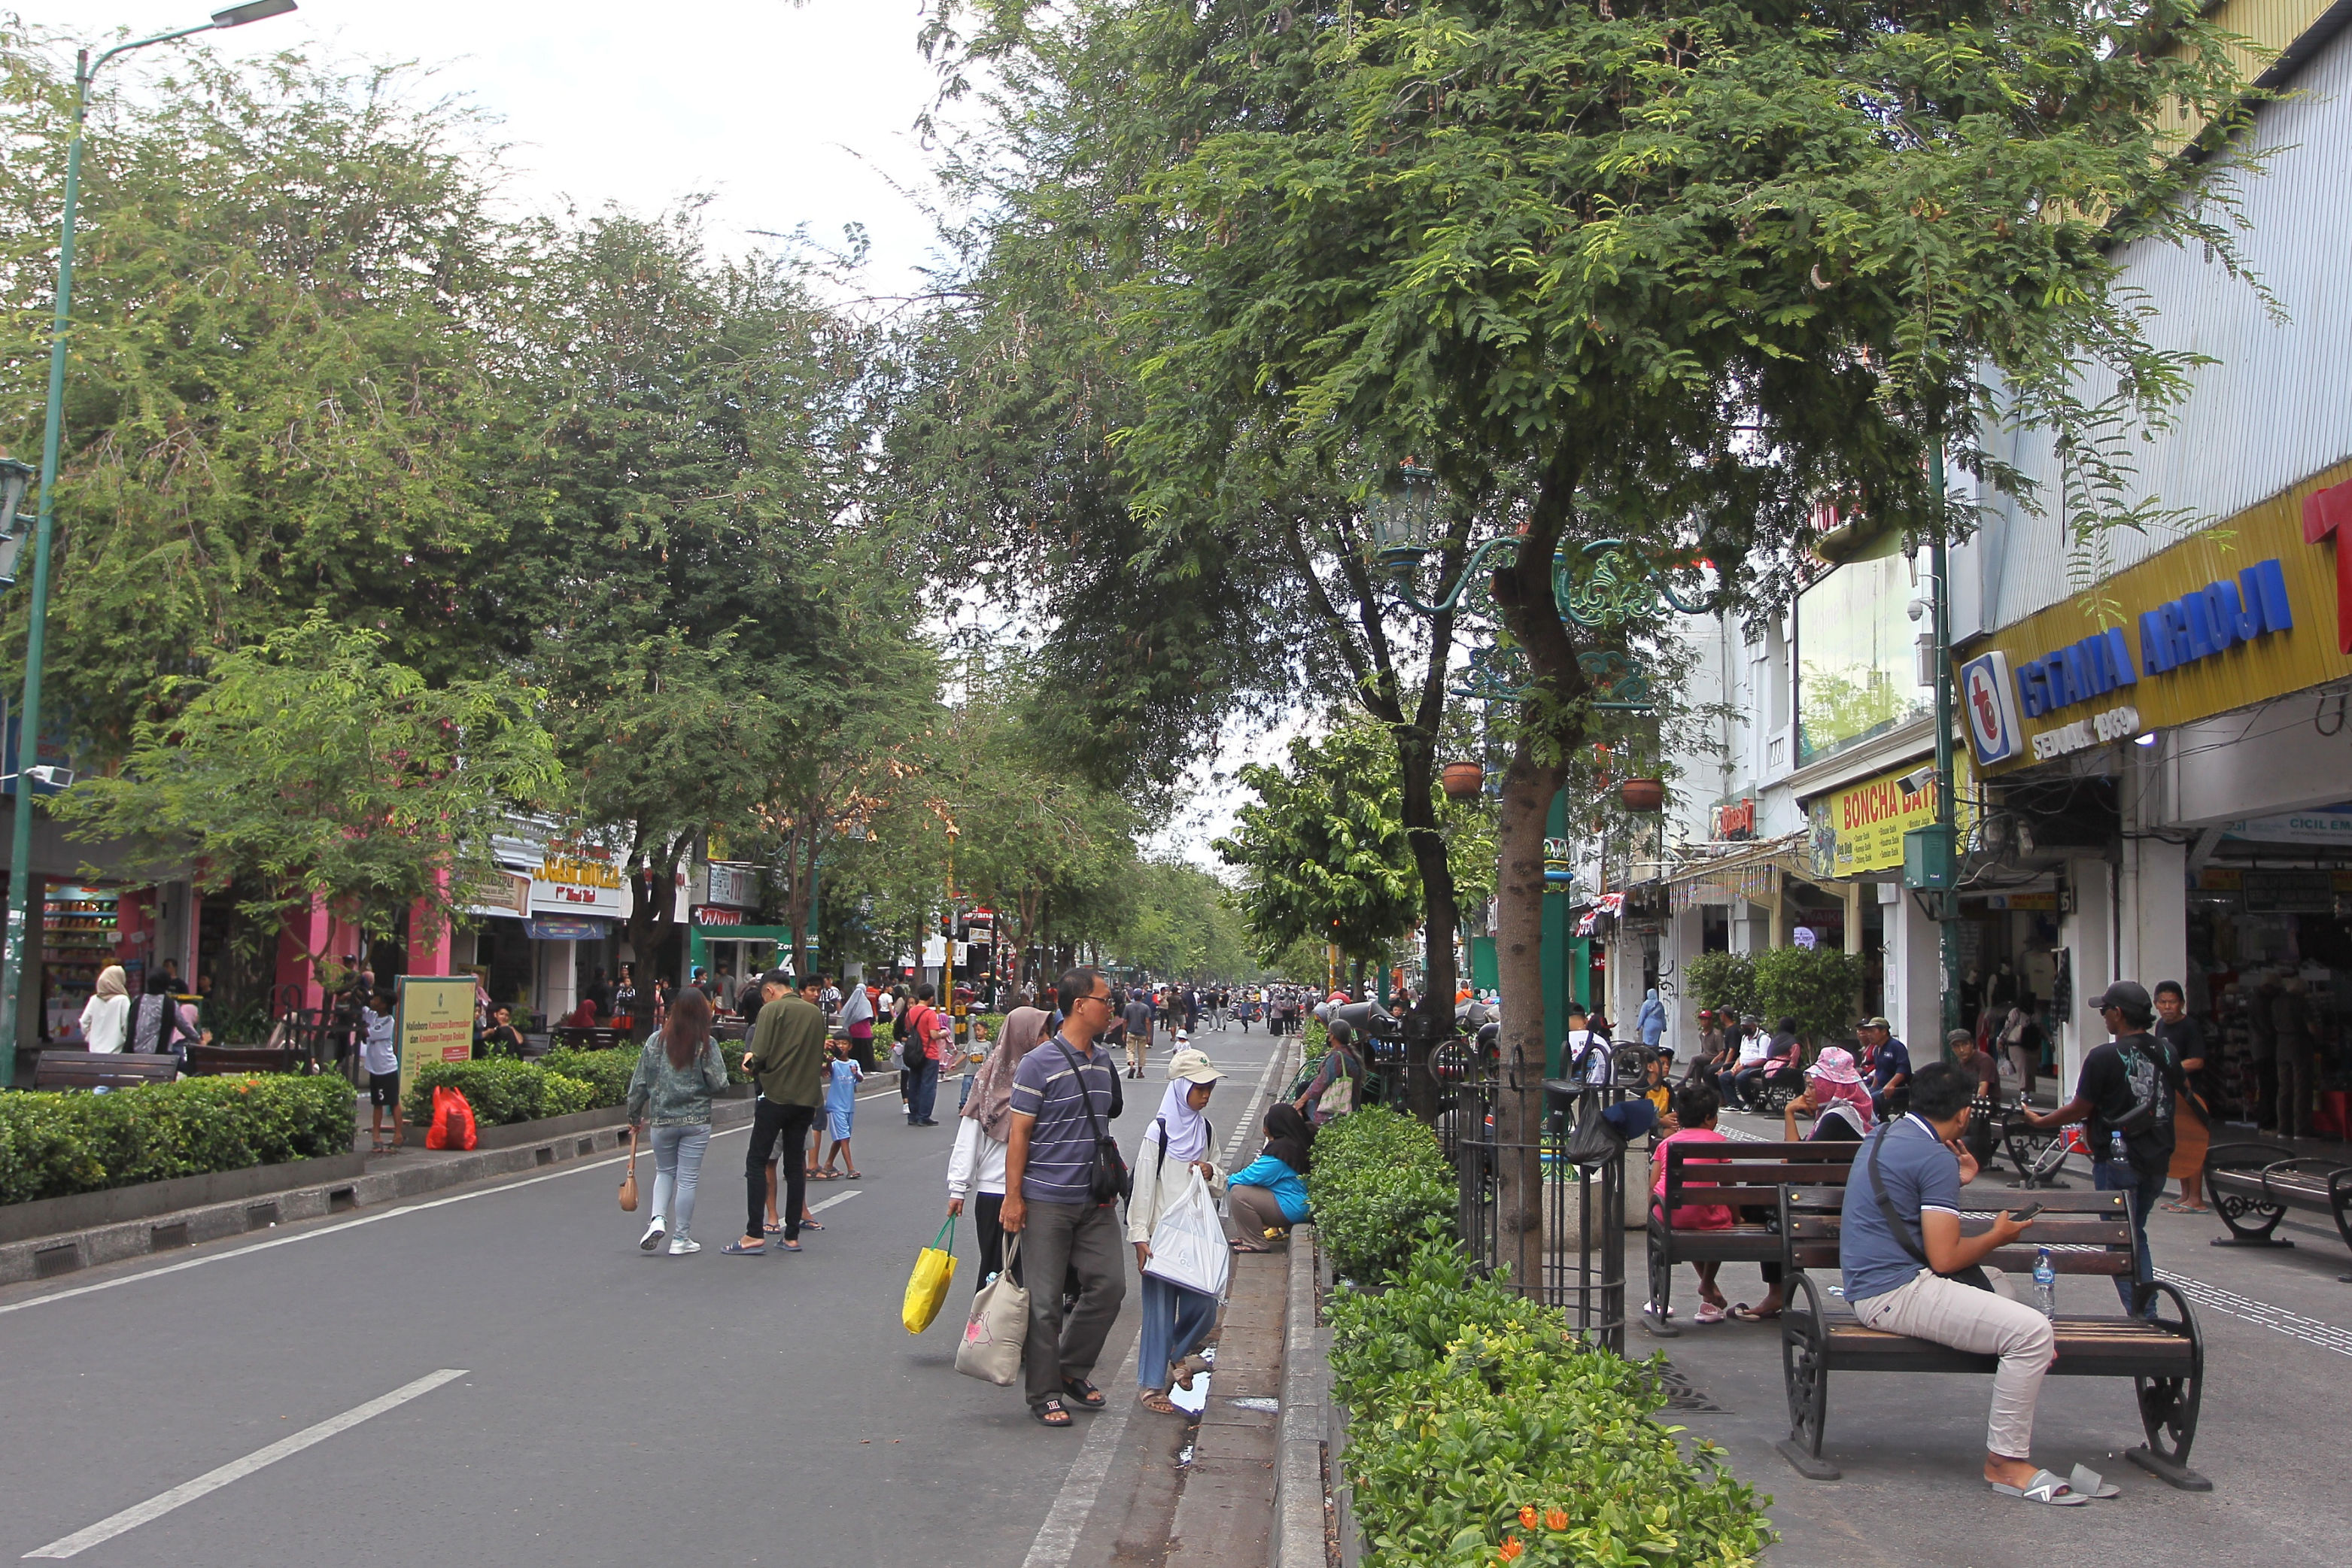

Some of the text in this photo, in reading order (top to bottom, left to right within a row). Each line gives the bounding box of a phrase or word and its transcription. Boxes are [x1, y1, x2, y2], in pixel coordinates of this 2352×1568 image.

[2015, 627, 2137, 719] ISTANA
[2138, 558, 2293, 676] ARLOJI
[2093, 707, 2138, 743] 1939
[1843, 779, 1899, 831] BONCHA
[1902, 766, 1937, 814] BATI
[2290, 818, 2326, 830] CICIL
[778, 953, 796, 976] 4
[406, 1020, 428, 1031] Malioboro
[409, 1035, 419, 1044] dan
[378, 1088, 384, 1101] 5
